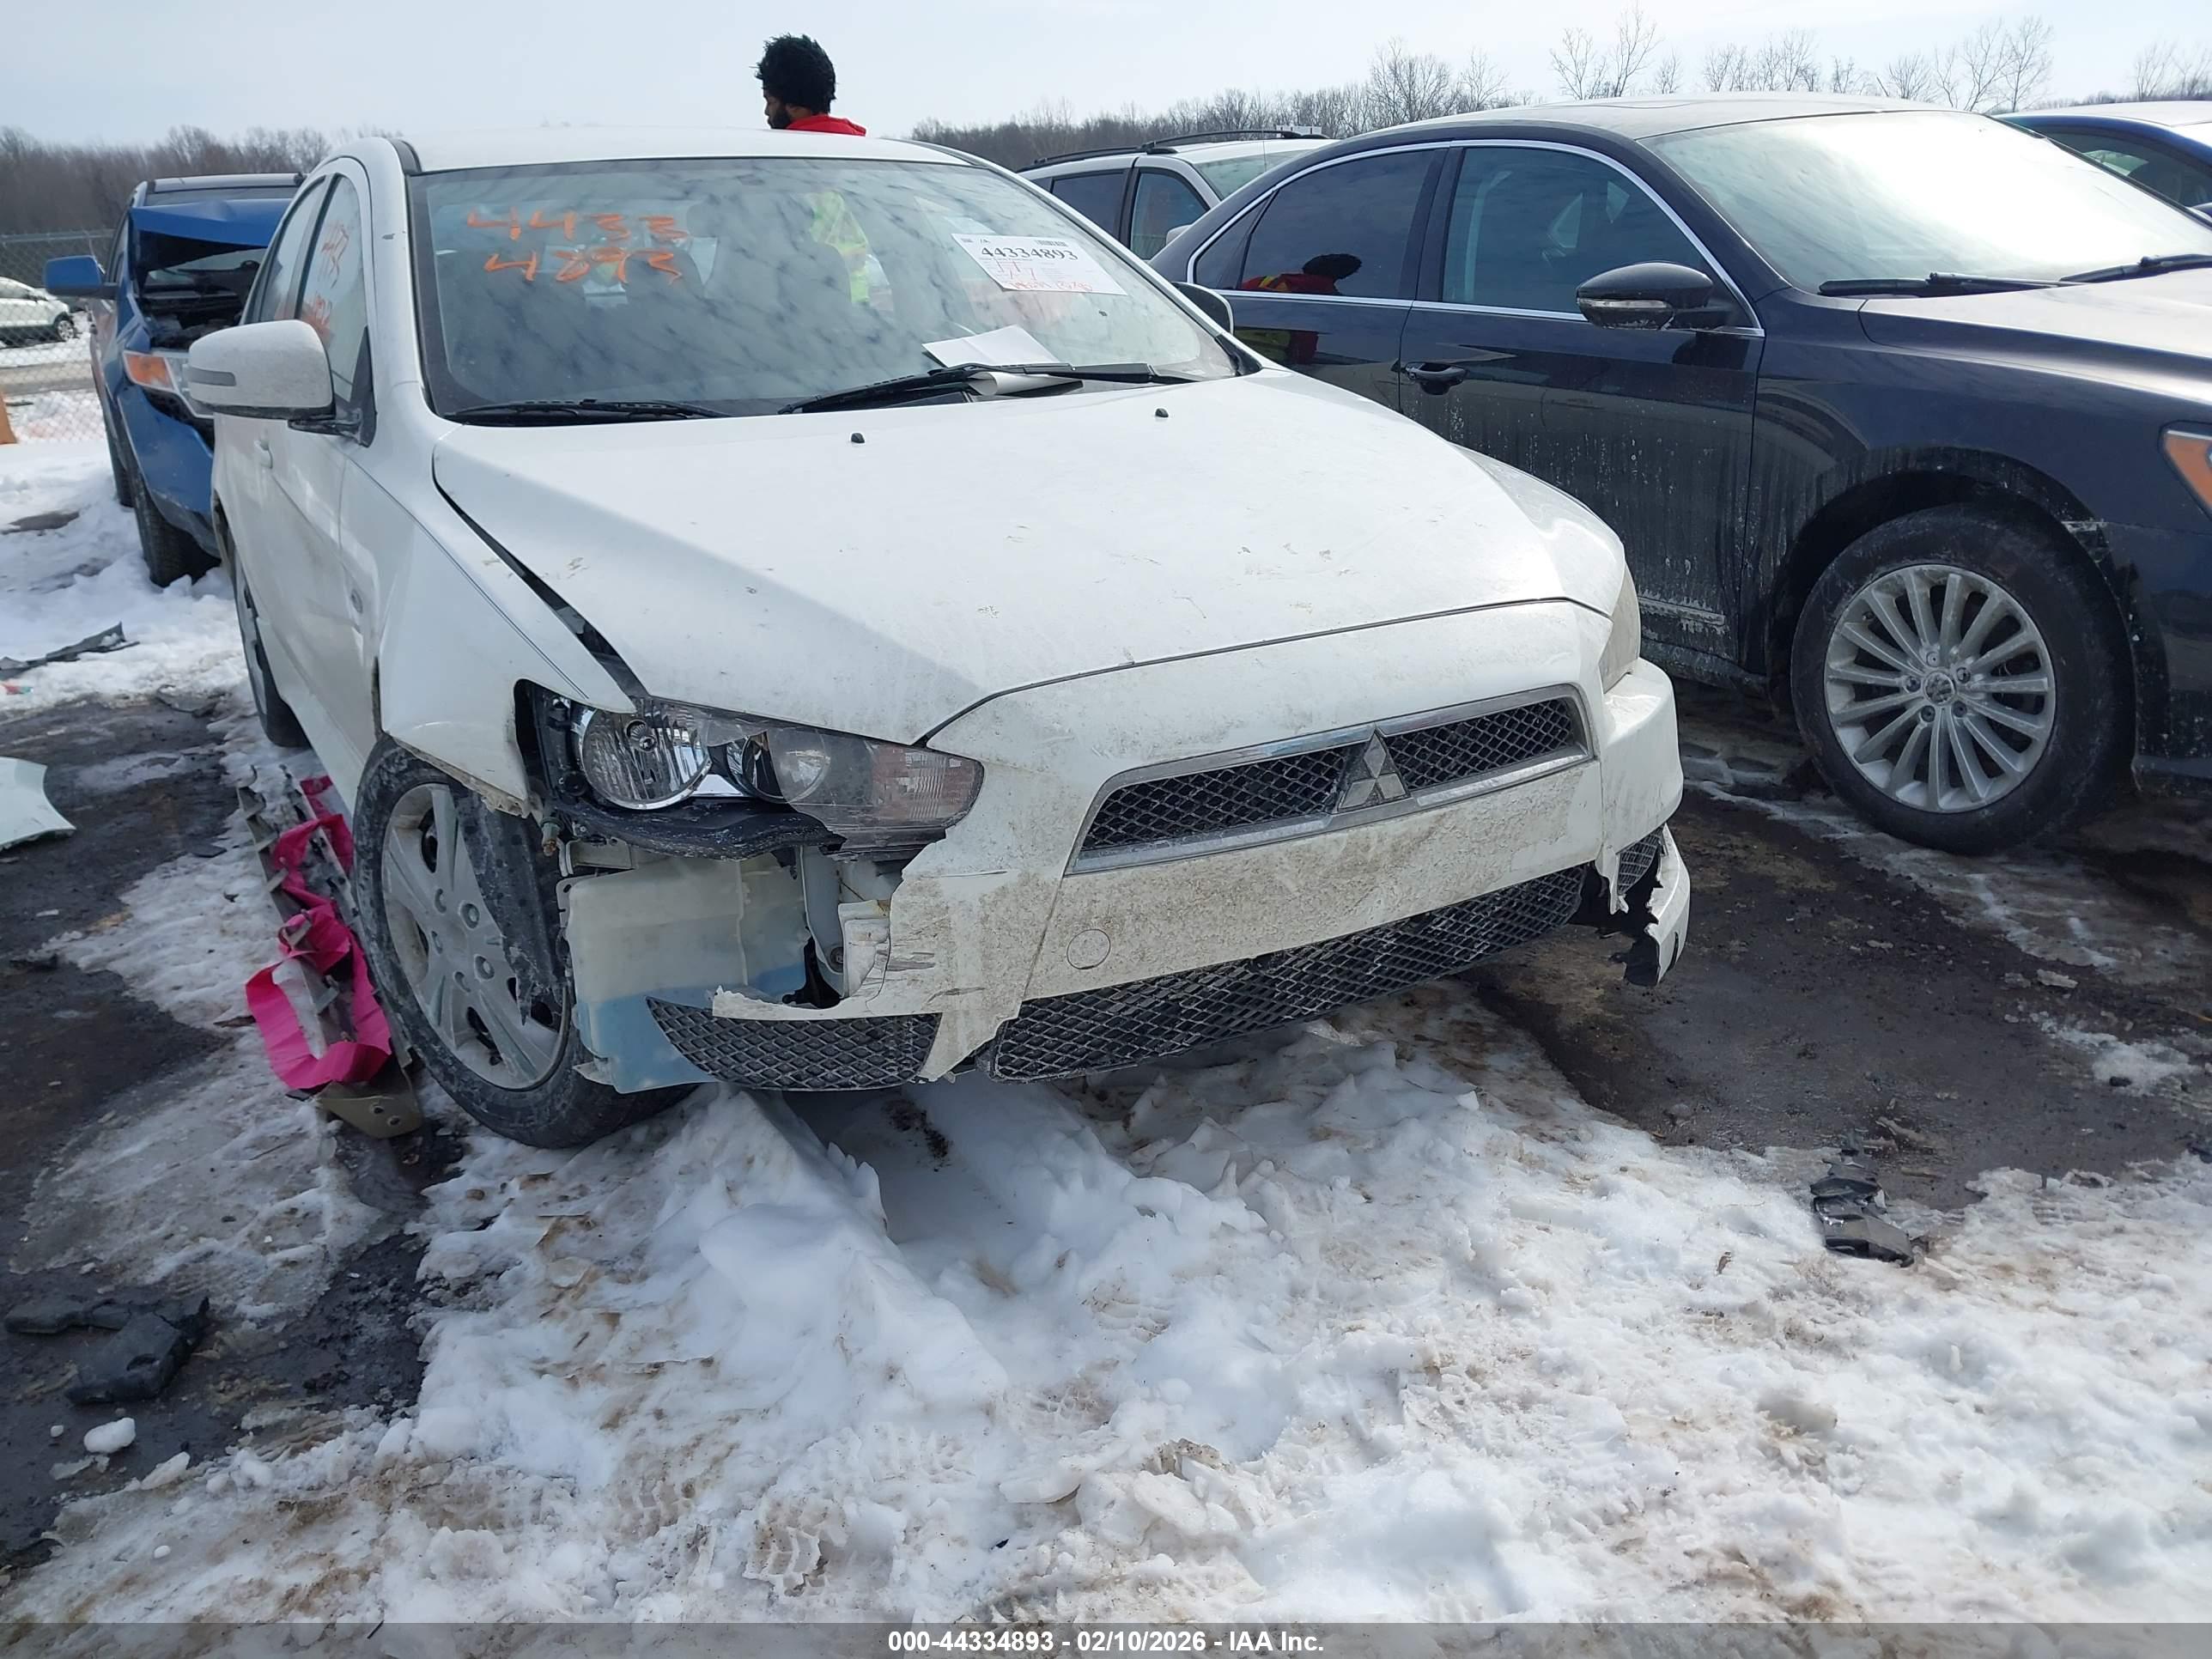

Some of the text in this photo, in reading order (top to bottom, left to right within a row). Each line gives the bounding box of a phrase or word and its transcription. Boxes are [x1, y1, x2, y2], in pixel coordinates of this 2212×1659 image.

[465, 205, 689, 241] 4433
[483, 246, 684, 284] 4893
[981, 246, 1079, 261] 44334893
